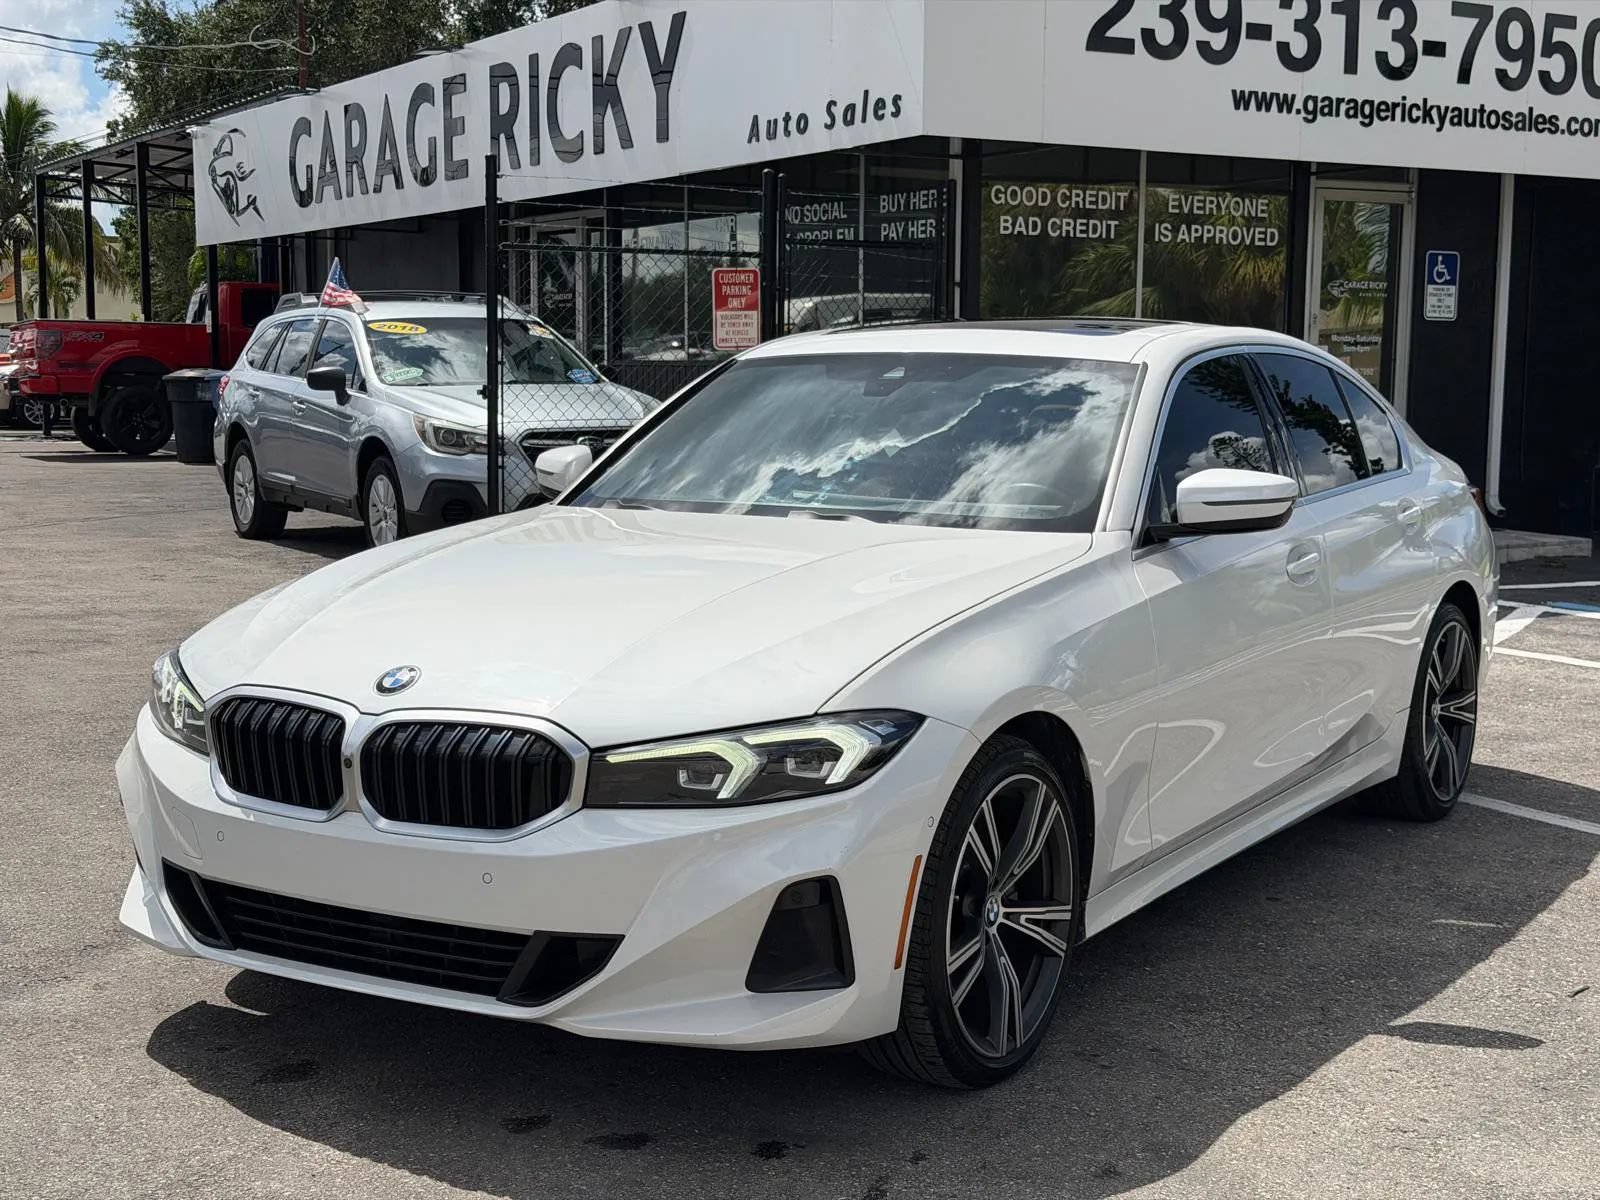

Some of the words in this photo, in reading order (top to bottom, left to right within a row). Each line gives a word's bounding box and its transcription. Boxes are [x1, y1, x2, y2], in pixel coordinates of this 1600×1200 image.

[289, 73, 469, 208] GARAGE
[489, 11, 687, 169] RICKY
[747, 112, 809, 144] Auto
[824, 89, 902, 130] Sales
[879, 193, 907, 213] BUY
[909, 188, 947, 210] HER
[990, 185, 1051, 206] GOOD
[1056, 189, 1129, 211] CREDIT
[1168, 194, 1269, 218] EVERYONE
[803, 201, 848, 222] SOCIAL
[880, 222, 905, 242] PAY
[908, 218, 946, 239] HER
[999, 216, 1041, 235] BAD
[1047, 217, 1119, 239] CREDIT
[1154, 223, 1173, 242] IS
[1176, 224, 1279, 247] APPROVED
[718, 272, 754, 284] CUSTOMER
[721, 285, 752, 296] PARKING
[727, 297, 746, 309] ONLY
[375, 323, 420, 333] 2018
